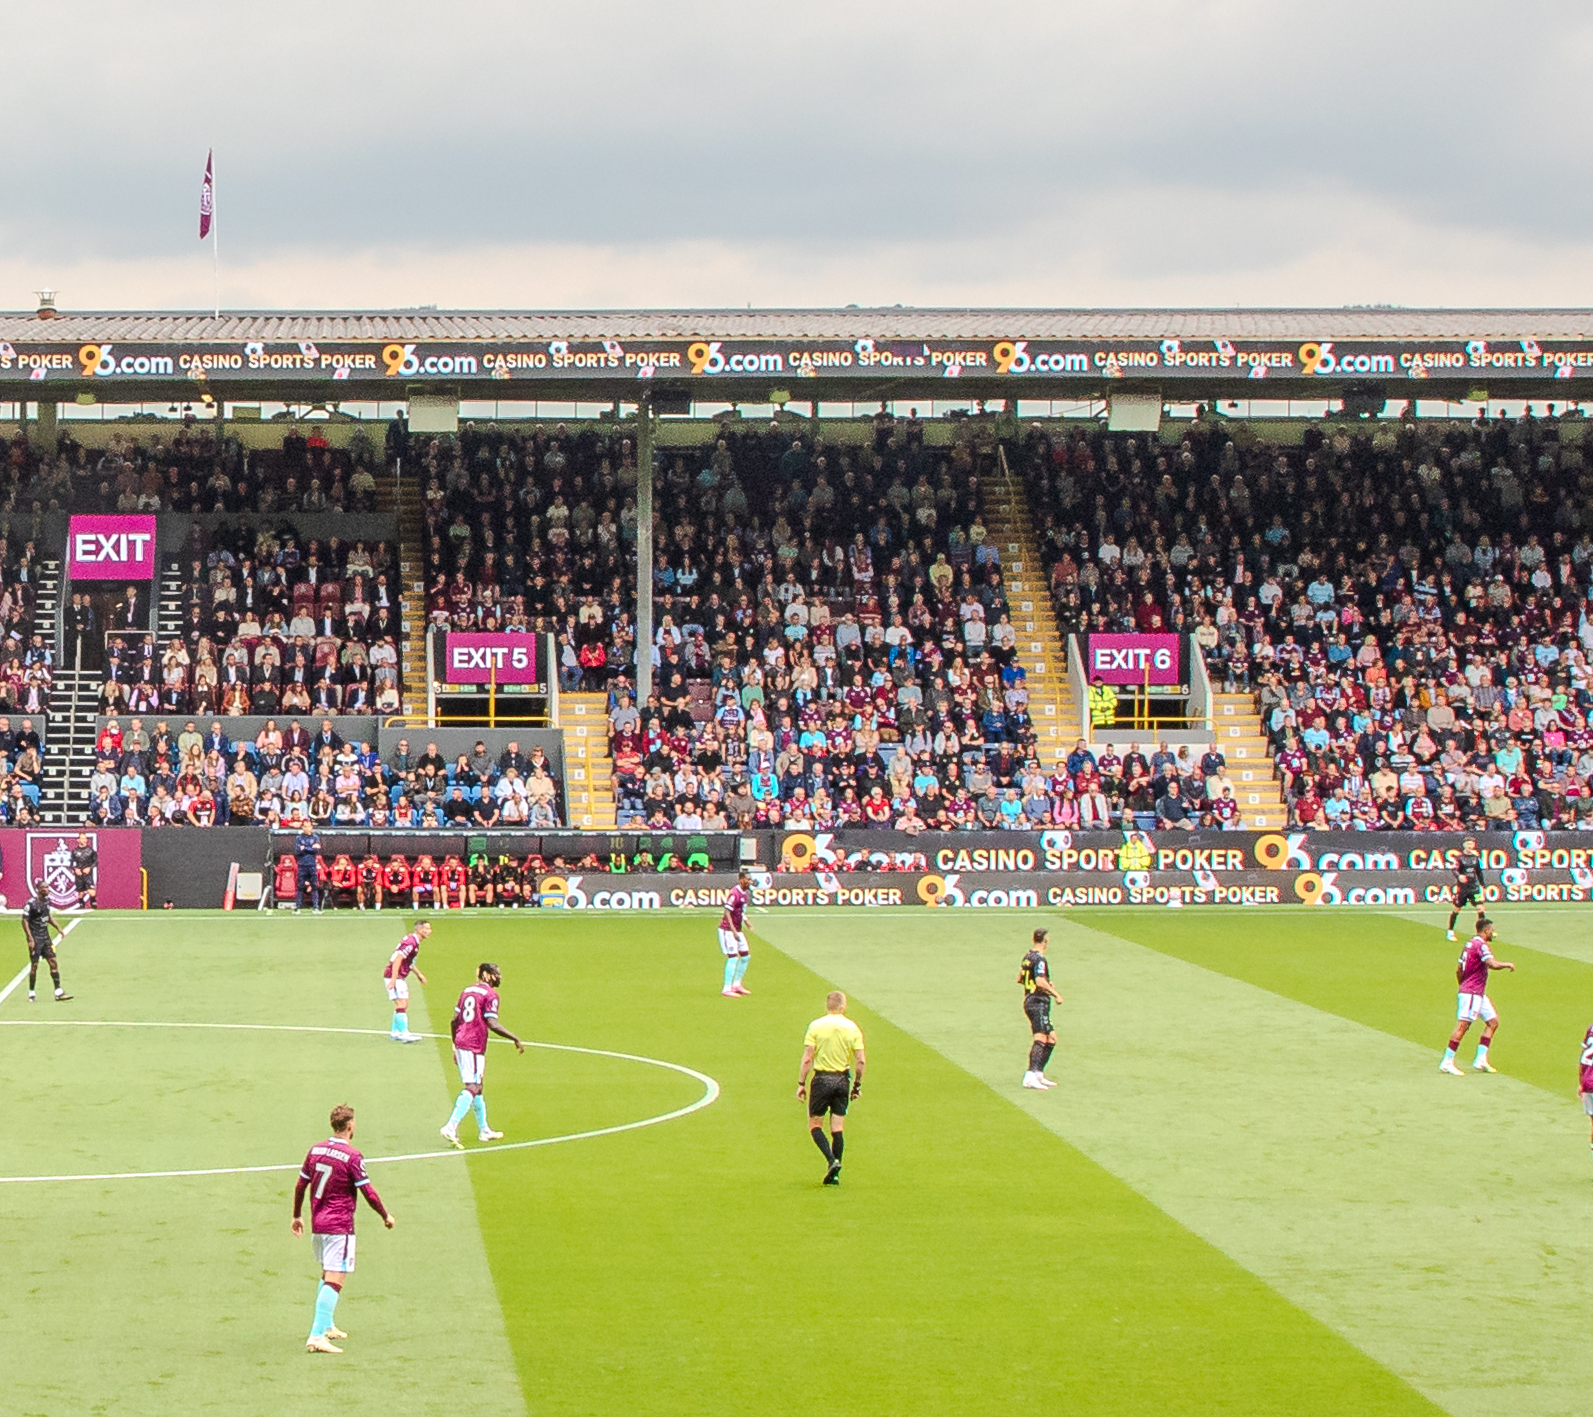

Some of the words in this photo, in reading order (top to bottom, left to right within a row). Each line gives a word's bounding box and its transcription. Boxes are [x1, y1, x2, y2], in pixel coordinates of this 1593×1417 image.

[18, 355, 72, 369] POKER
[382, 344, 477, 376] 96.com
[483, 354, 547, 368] CASINO
[553, 353, 623, 368] SPORTS
[626, 353, 681, 367] POKER
[993, 342, 1088, 374] 96.com
[1094, 352, 1158, 366] CASINO
[1164, 352, 1235, 366] SPORTS
[1238, 352, 1292, 366] POKER
[74, 533, 151, 562] EXIT
[453, 648, 508, 669] EXIT
[512, 648, 527, 669] 5
[1095, 648, 1151, 670] EXIT
[1154, 648, 1171, 670] 6
[935, 849, 1034, 871] CASINO
[1157, 849, 1244, 871] POKER
[917, 874, 1038, 908] 96.com
[1048, 887, 1121, 904] CASINO
[1506, 885, 1583, 901] SPORTS
[462, 996, 475, 1023] 8
[315, 1162, 333, 1199] 7
